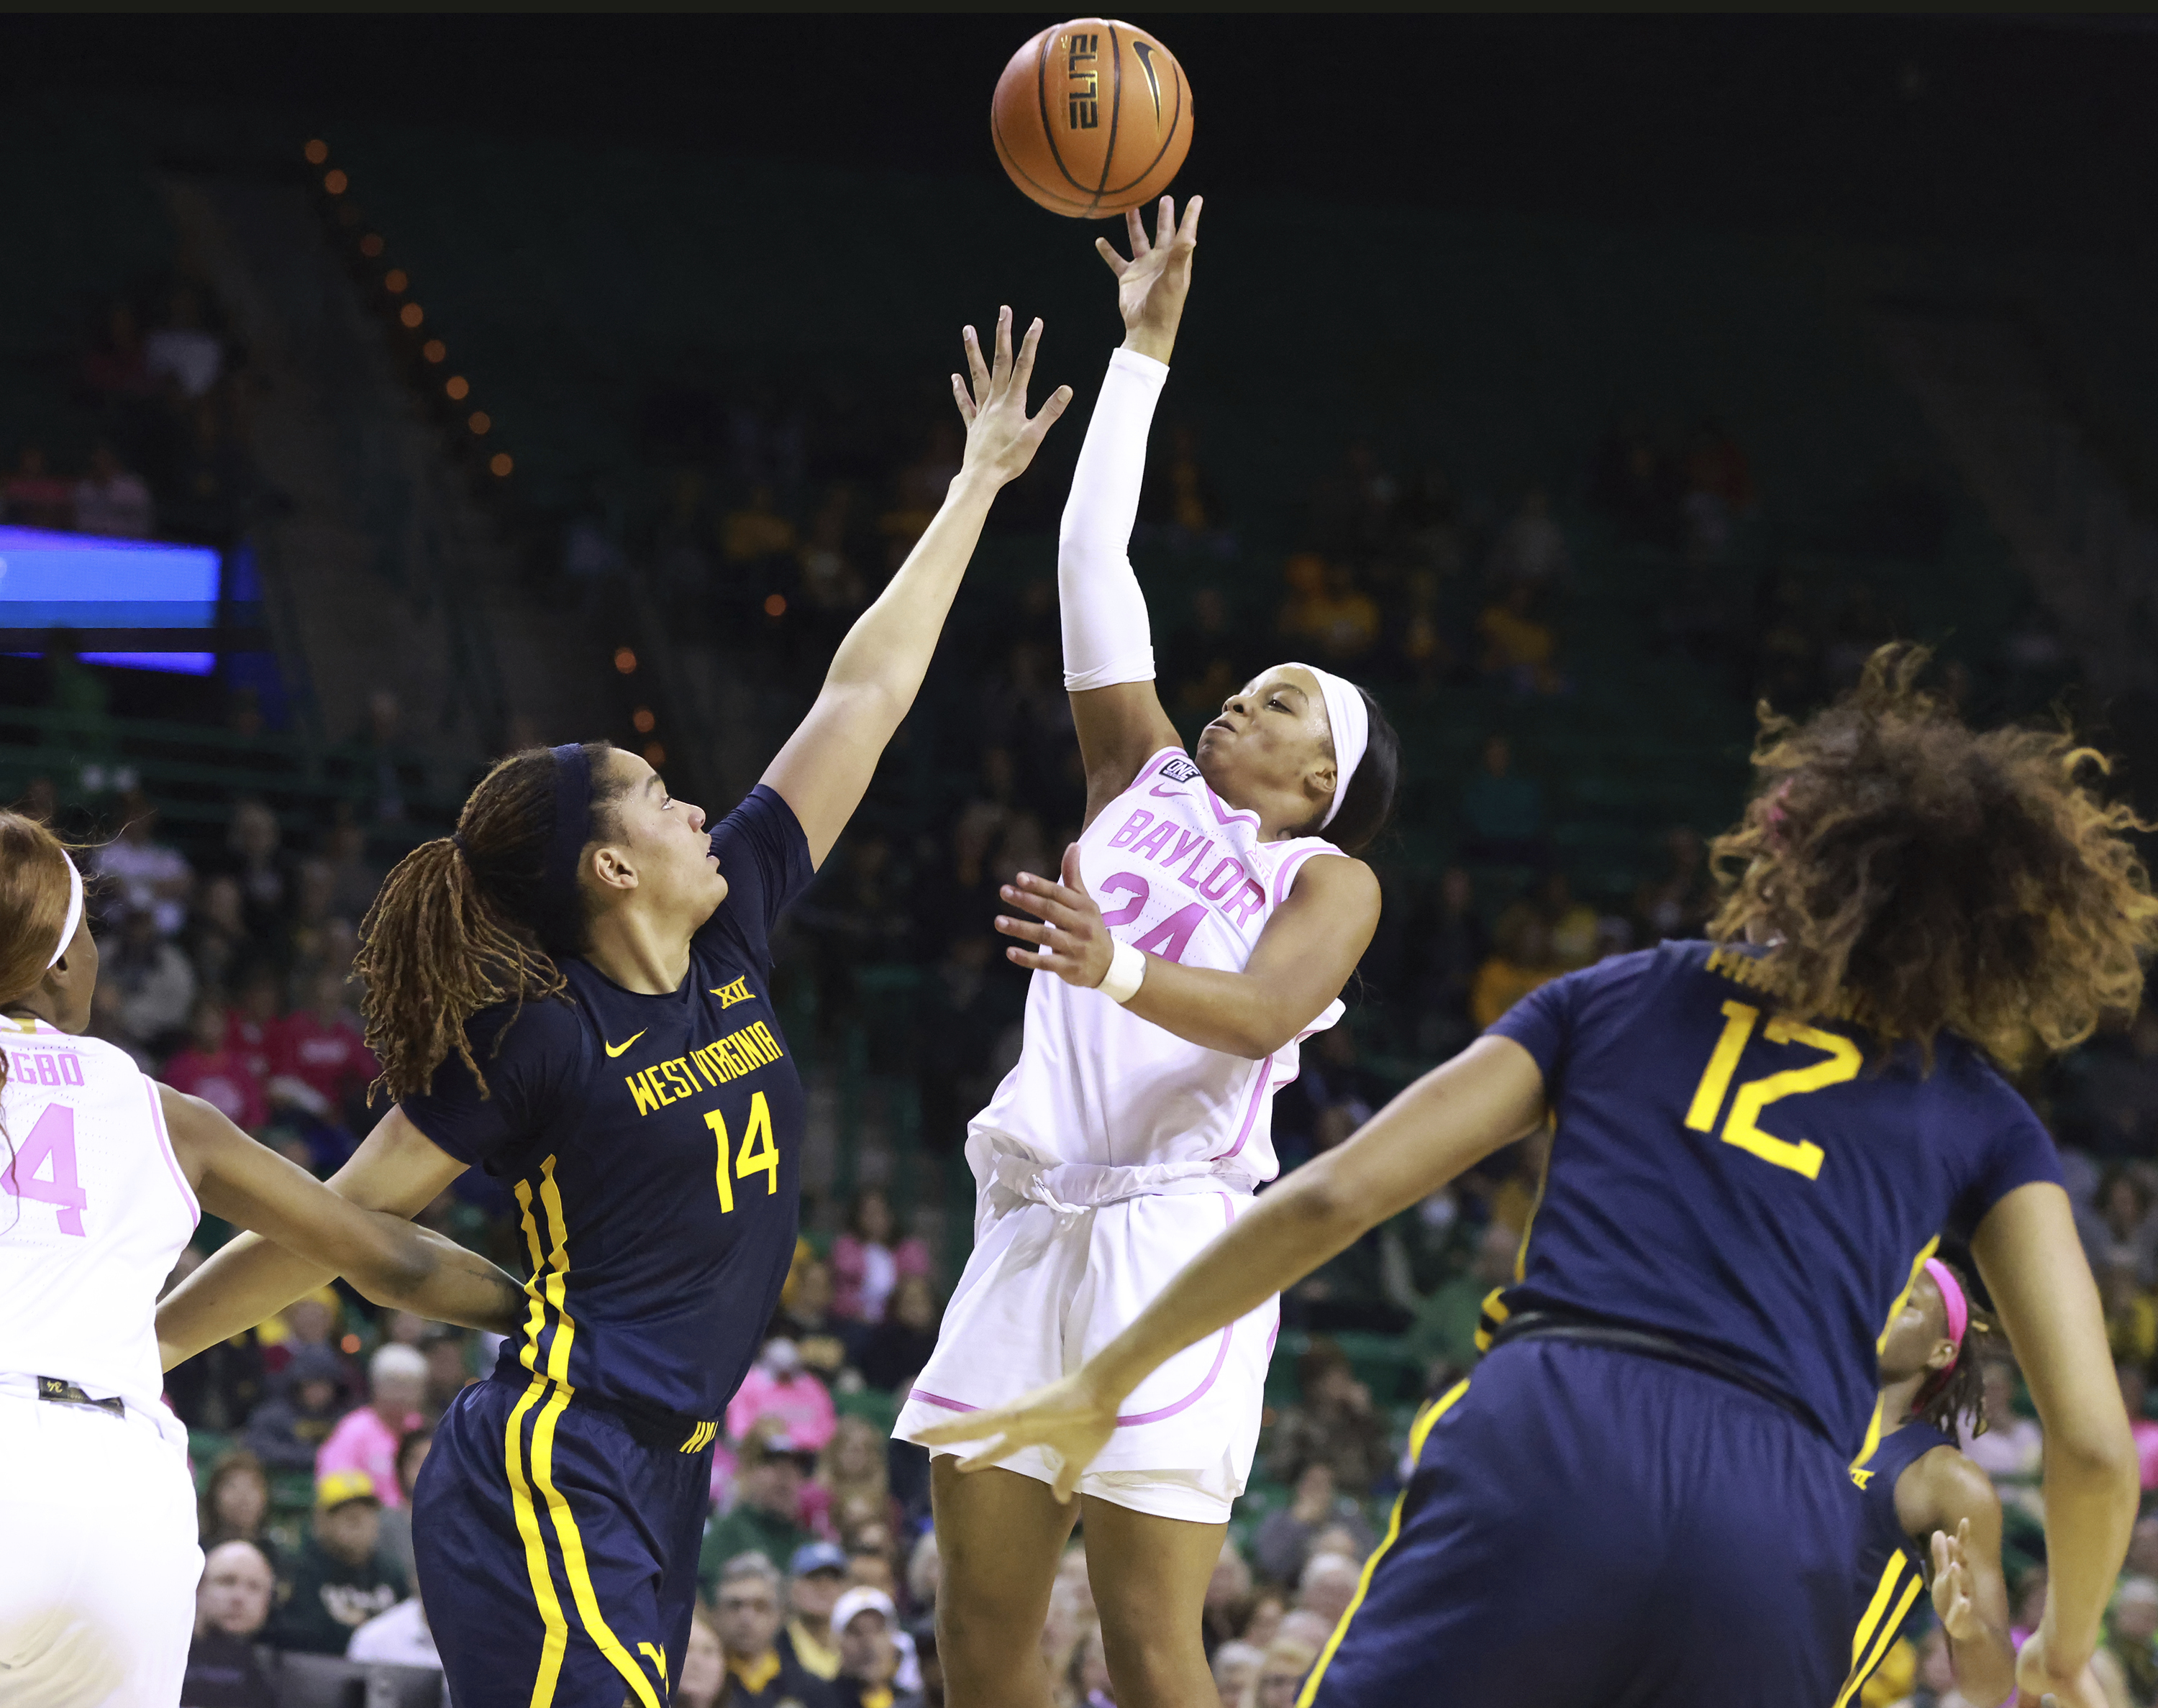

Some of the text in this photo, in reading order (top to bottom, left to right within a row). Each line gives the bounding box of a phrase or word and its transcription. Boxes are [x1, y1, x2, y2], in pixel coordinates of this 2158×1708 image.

[1069, 34, 1098, 129] ELITE
[1166, 759, 1200, 780] ONE
[1099, 871, 1210, 964] 24
[1106, 808, 1267, 930] BAYLOR
[3, 1051, 85, 1087] GBO
[624, 1020, 784, 1117] WEST VIRGINIA
[1684, 999, 1865, 1182] 12
[0, 1102, 88, 1238] 4
[703, 1090, 780, 1214] 14
